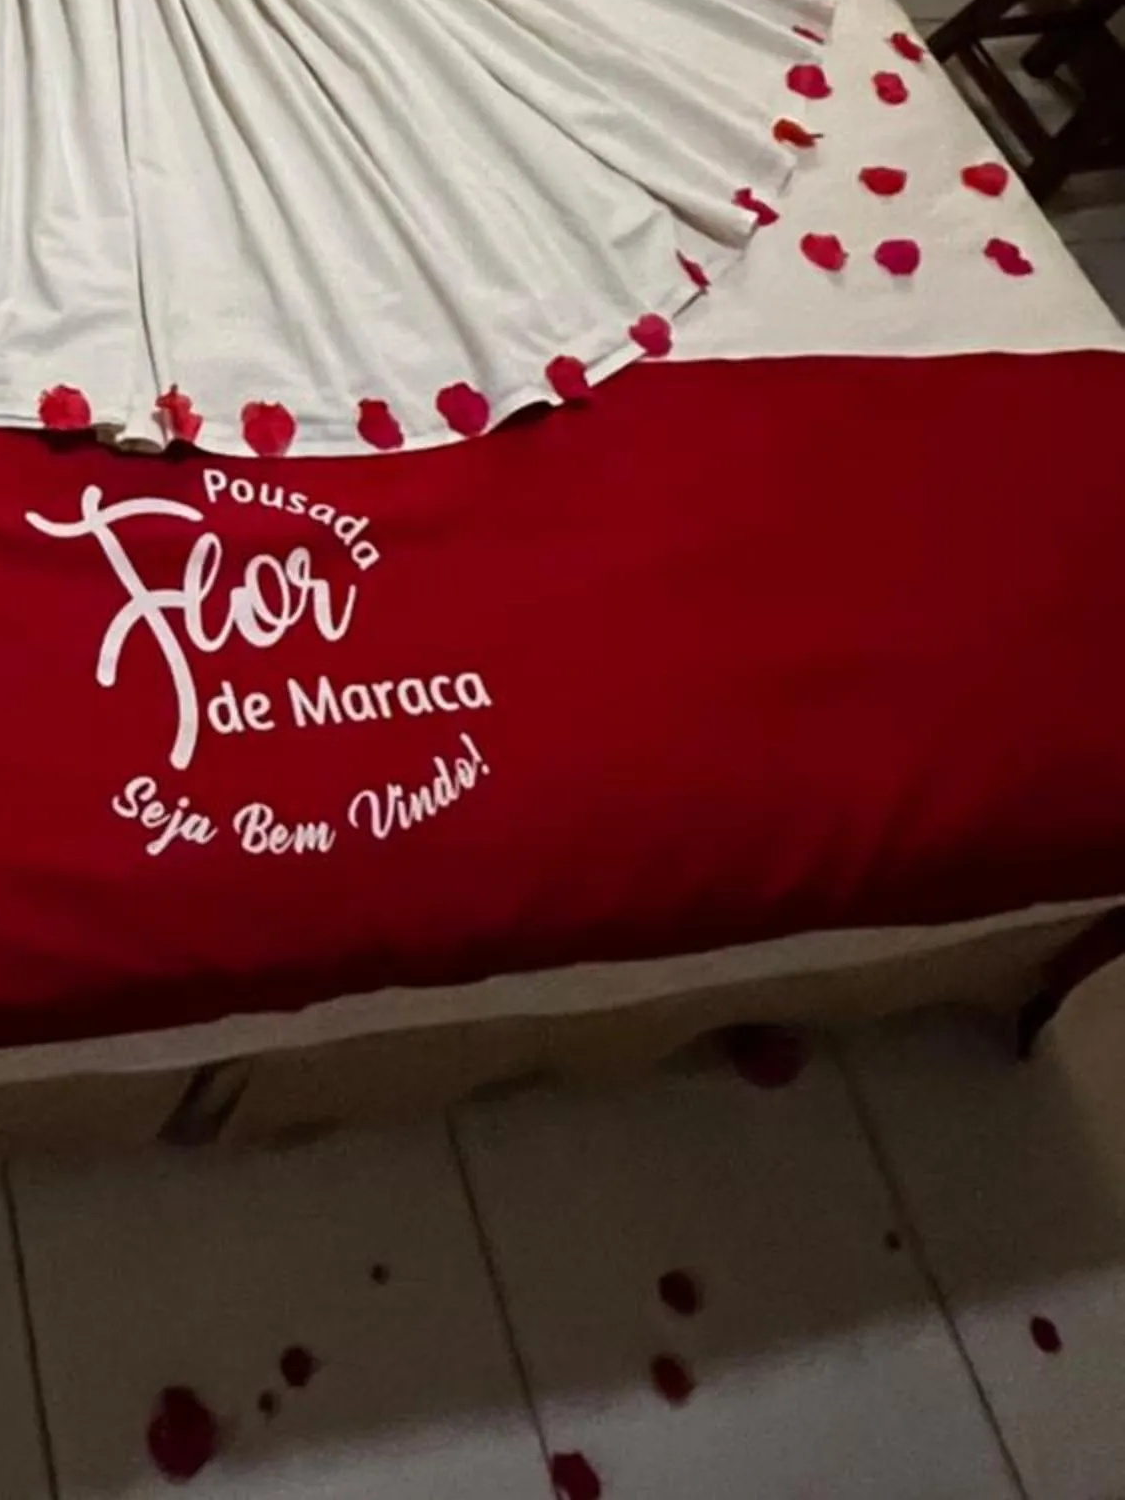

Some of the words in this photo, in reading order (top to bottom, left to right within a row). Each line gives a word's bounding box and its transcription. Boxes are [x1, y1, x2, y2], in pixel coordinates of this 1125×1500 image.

[203, 468, 380, 571] Pousada
[24, 484, 357, 770] Flor
[207, 680, 276, 734] de
[287, 672, 492, 728] Maraca
[112, 776, 218, 856] Seja
[233, 802, 336, 854] Bem
[348, 732, 491, 839] Vindo!
